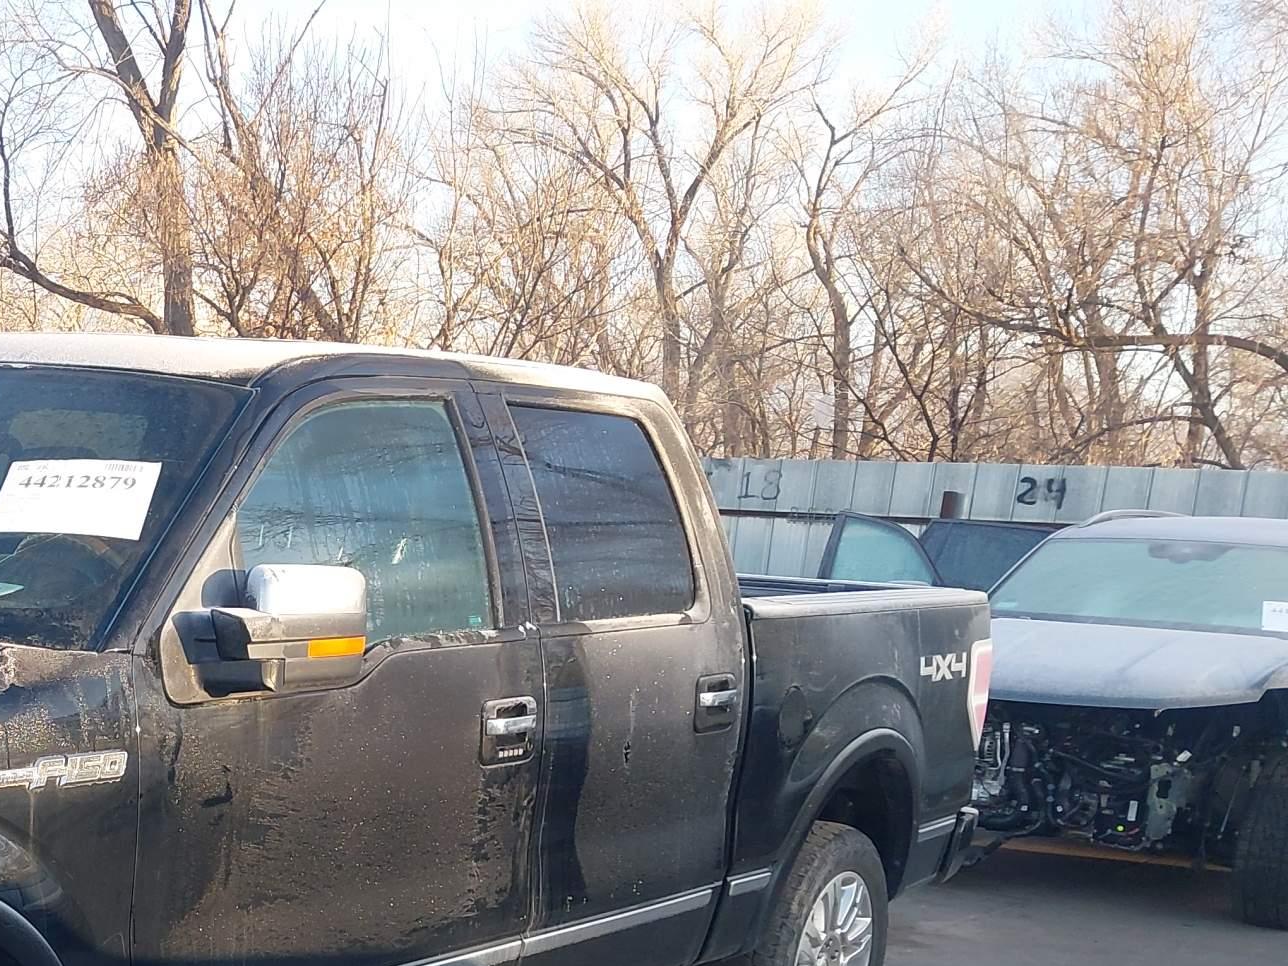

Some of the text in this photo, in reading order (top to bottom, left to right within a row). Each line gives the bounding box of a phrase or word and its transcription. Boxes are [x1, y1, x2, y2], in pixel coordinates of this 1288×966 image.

[18, 474, 137, 490] 44212879
[1017, 476, 1066, 510] 24
[919, 652, 967, 681] 4X4
